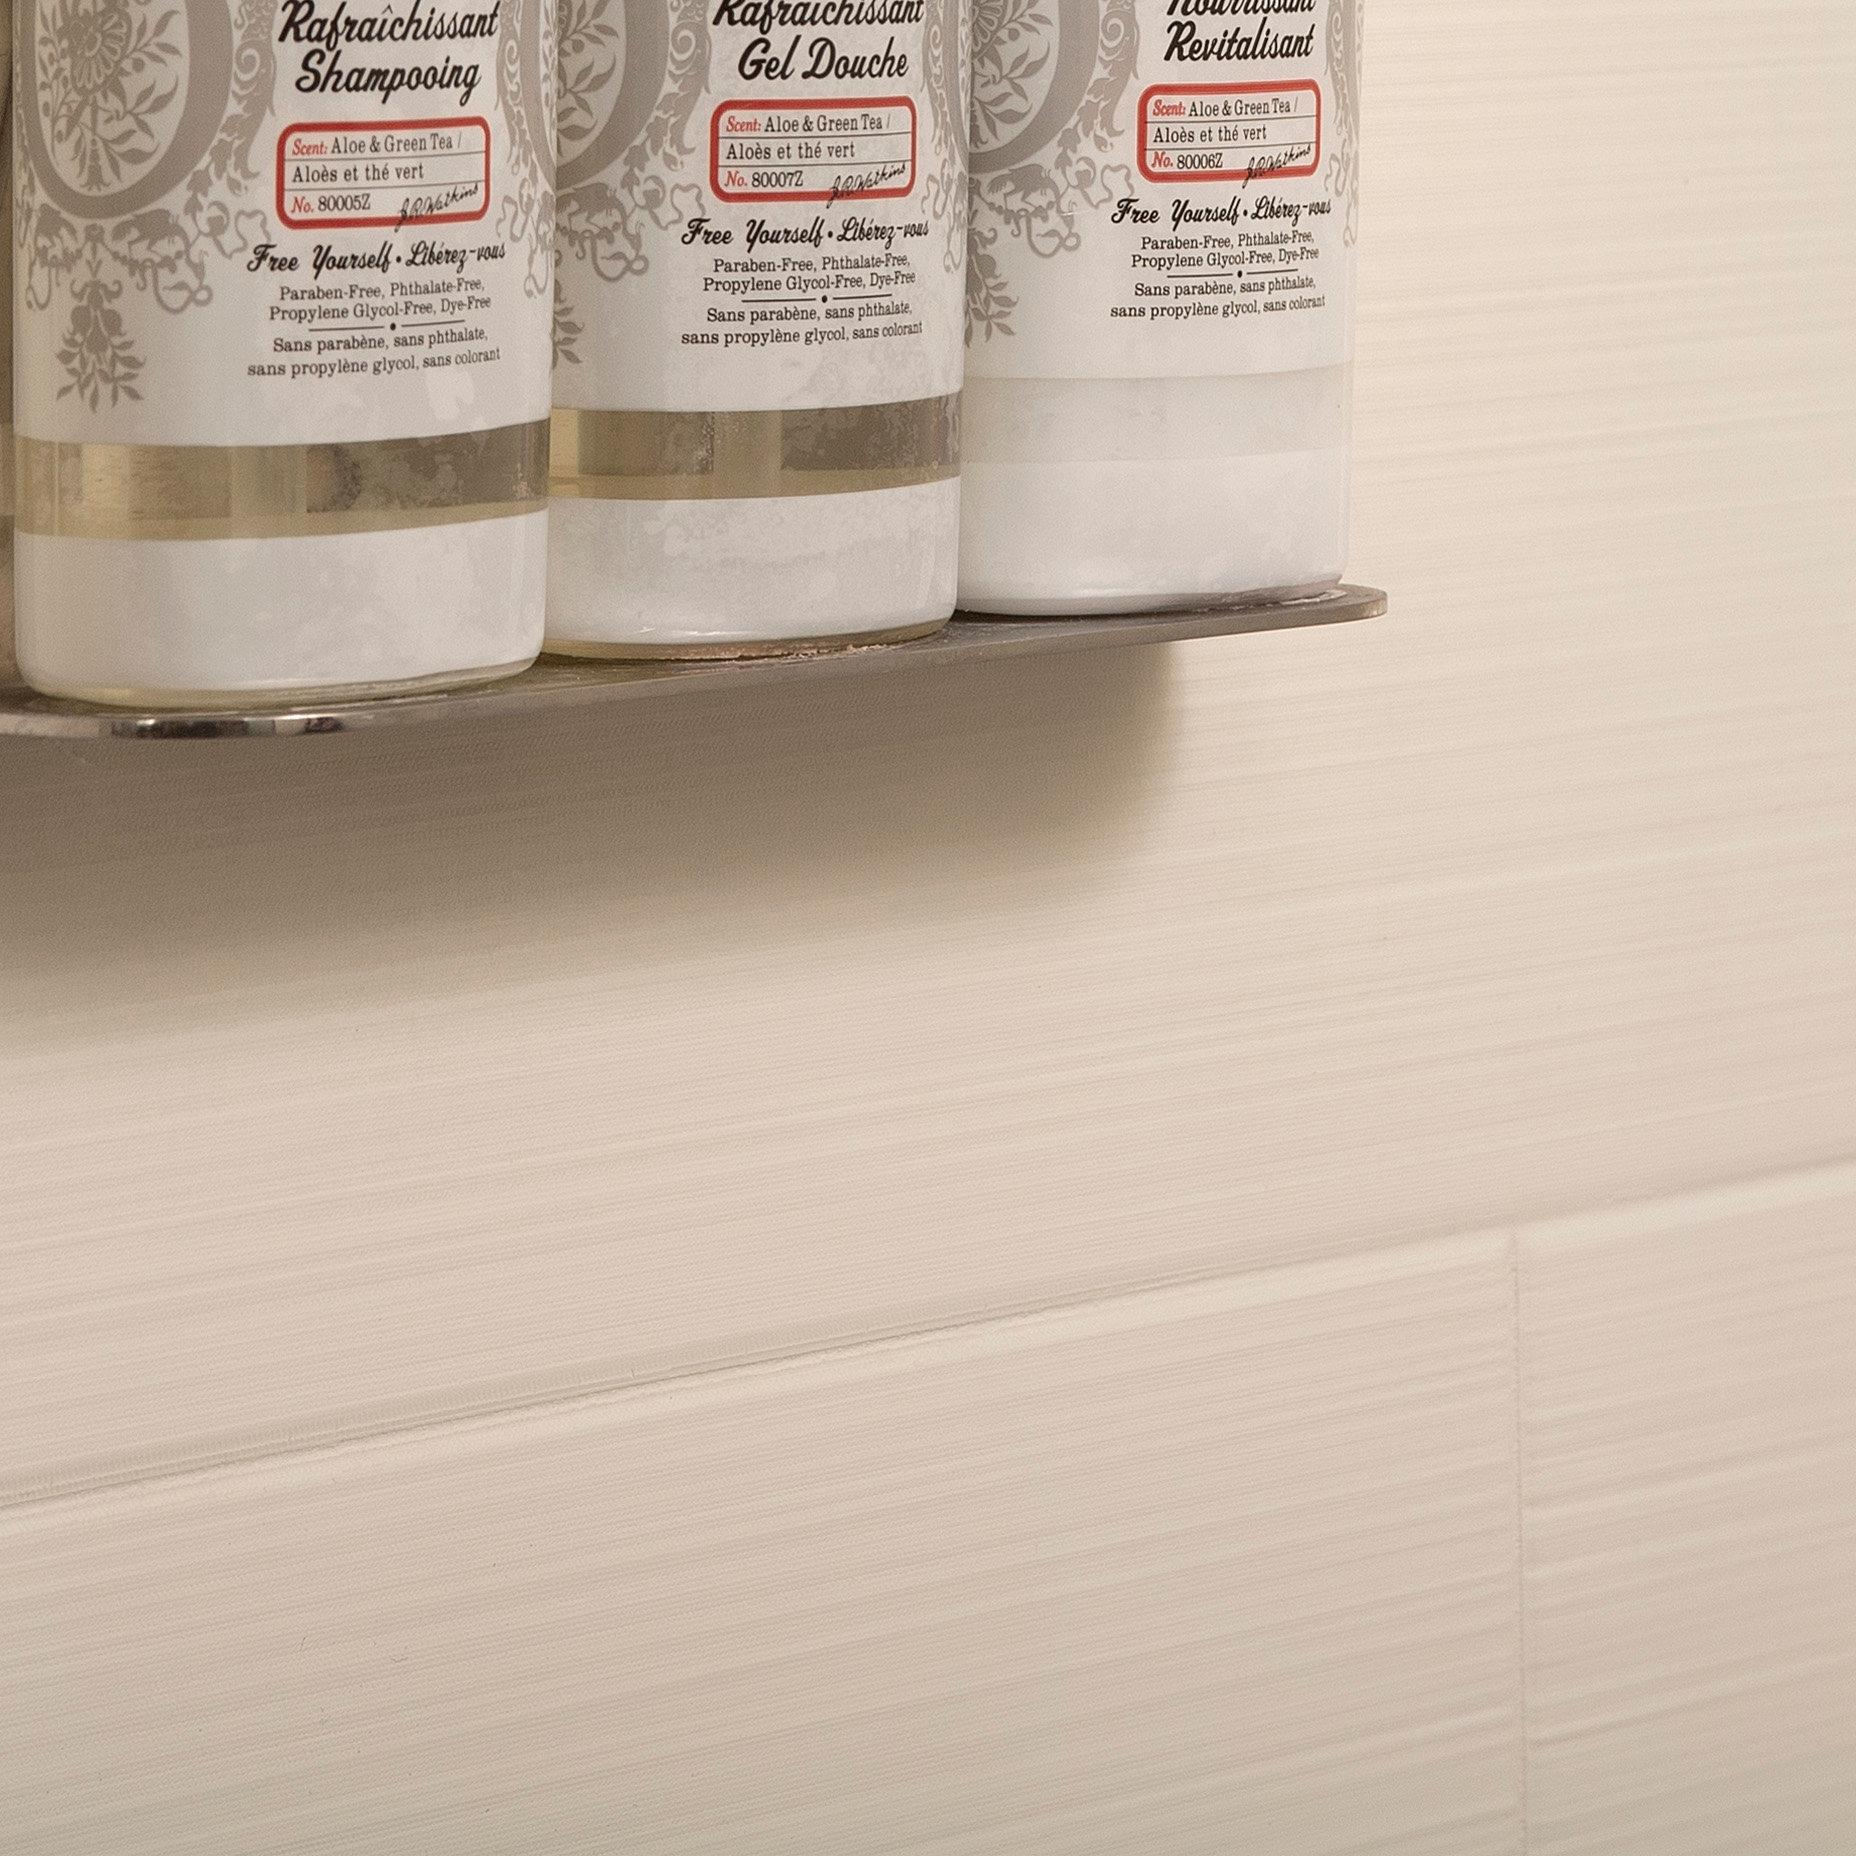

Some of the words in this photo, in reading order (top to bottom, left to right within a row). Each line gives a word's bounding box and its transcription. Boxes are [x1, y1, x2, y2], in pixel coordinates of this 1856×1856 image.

[1164, 16, 1316, 61] Revitalisant
[738, 34, 802, 80] Gel
[802, 36, 908, 79] Douche
[295, 48, 480, 106] Shampooing
[1152, 99, 1185, 116] Scent:
[1188, 100, 1219, 117] Aloe
[1222, 100, 1232, 115] &
[1234, 99, 1270, 115] Green
[1272, 98, 1290, 114] Tea
[726, 116, 761, 132] Scent:
[764, 115, 799, 132] Aloe
[802, 116, 814, 132] &
[817, 114, 858, 131] Green
[862, 114, 882, 130] Tea
[1153, 126, 1194, 143] Aloès
[1200, 128, 1212, 142] et
[1218, 126, 1238, 141] thé
[1244, 125, 1266, 140] vert
[292, 139, 328, 156] Scent:
[331, 137, 366, 154] Aloe
[370, 136, 380, 152] &
[384, 135, 427, 152] Green
[431, 135, 453, 149] Tea
[726, 142, 771, 160] Aloès
[777, 144, 792, 159] et
[798, 142, 822, 158] thé
[827, 141, 855, 158] vert
[1151, 151, 1174, 168] No.
[1177, 153, 1223, 169] 80006Z
[293, 165, 338, 182] Aloès
[344, 166, 359, 180] et
[366, 162, 389, 180] thé
[396, 162, 424, 179] vert
[724, 170, 747, 187] No.
[752, 170, 803, 187] 80007Z
[291, 197, 314, 213] No.
[318, 194, 371, 212] 80005Z
[1111, 197, 1160, 224] Free
[1171, 196, 1241, 232] Yourself
[681, 217, 733, 245] Free
[746, 216, 825, 253] Yourself
[1141, 236, 1234, 250] Paraben-Free,
[1238, 230, 1314, 246] Phthalate-Free,
[247, 243, 299, 272] Free
[312, 241, 393, 280] Yourself
[713, 258, 817, 273] Paraben-Free,
[822, 253, 910, 271] Phthalate-Free,
[1132, 253, 1204, 270] Propylene
[1206, 250, 1275, 268] Glycol-Free,
[1278, 246, 1319, 264] Dye-Free
[280, 284, 385, 300] Paraben-Free,
[390, 277, 484, 297] Phthalate-Free,
[703, 277, 782, 295] Propylene
[786, 275, 866, 293] Glycol-Free,
[870, 270, 916, 290] Dye-Free
[1135, 282, 1170, 296] Sans
[1240, 280, 1265, 293] sans
[1268, 276, 1316, 294] phthalate,
[270, 306, 349, 323] Propylene
[353, 300, 436, 321] Glycol-Free,
[441, 295, 491, 314] Dye-Free
[707, 308, 745, 322] Sans
[825, 304, 854, 319] sans
[858, 301, 912, 321] phthalate,
[1110, 306, 1146, 318] sans
[1222, 300, 1261, 318] glycol,
[1263, 300, 1286, 312] sans
[1289, 294, 1326, 310] colorant
[274, 338, 312, 352] Sans
[393, 331, 424, 346] sans
[429, 327, 487, 346] phthalate,
[682, 332, 719, 345] sans
[804, 328, 849, 345] glycol,
[852, 326, 879, 339] sans
[882, 321, 922, 337] colorant
[247, 363, 286, 376] sans
[372, 356, 419, 375] glycol,
[423, 354, 451, 368] sans
[455, 348, 500, 365] colorant
